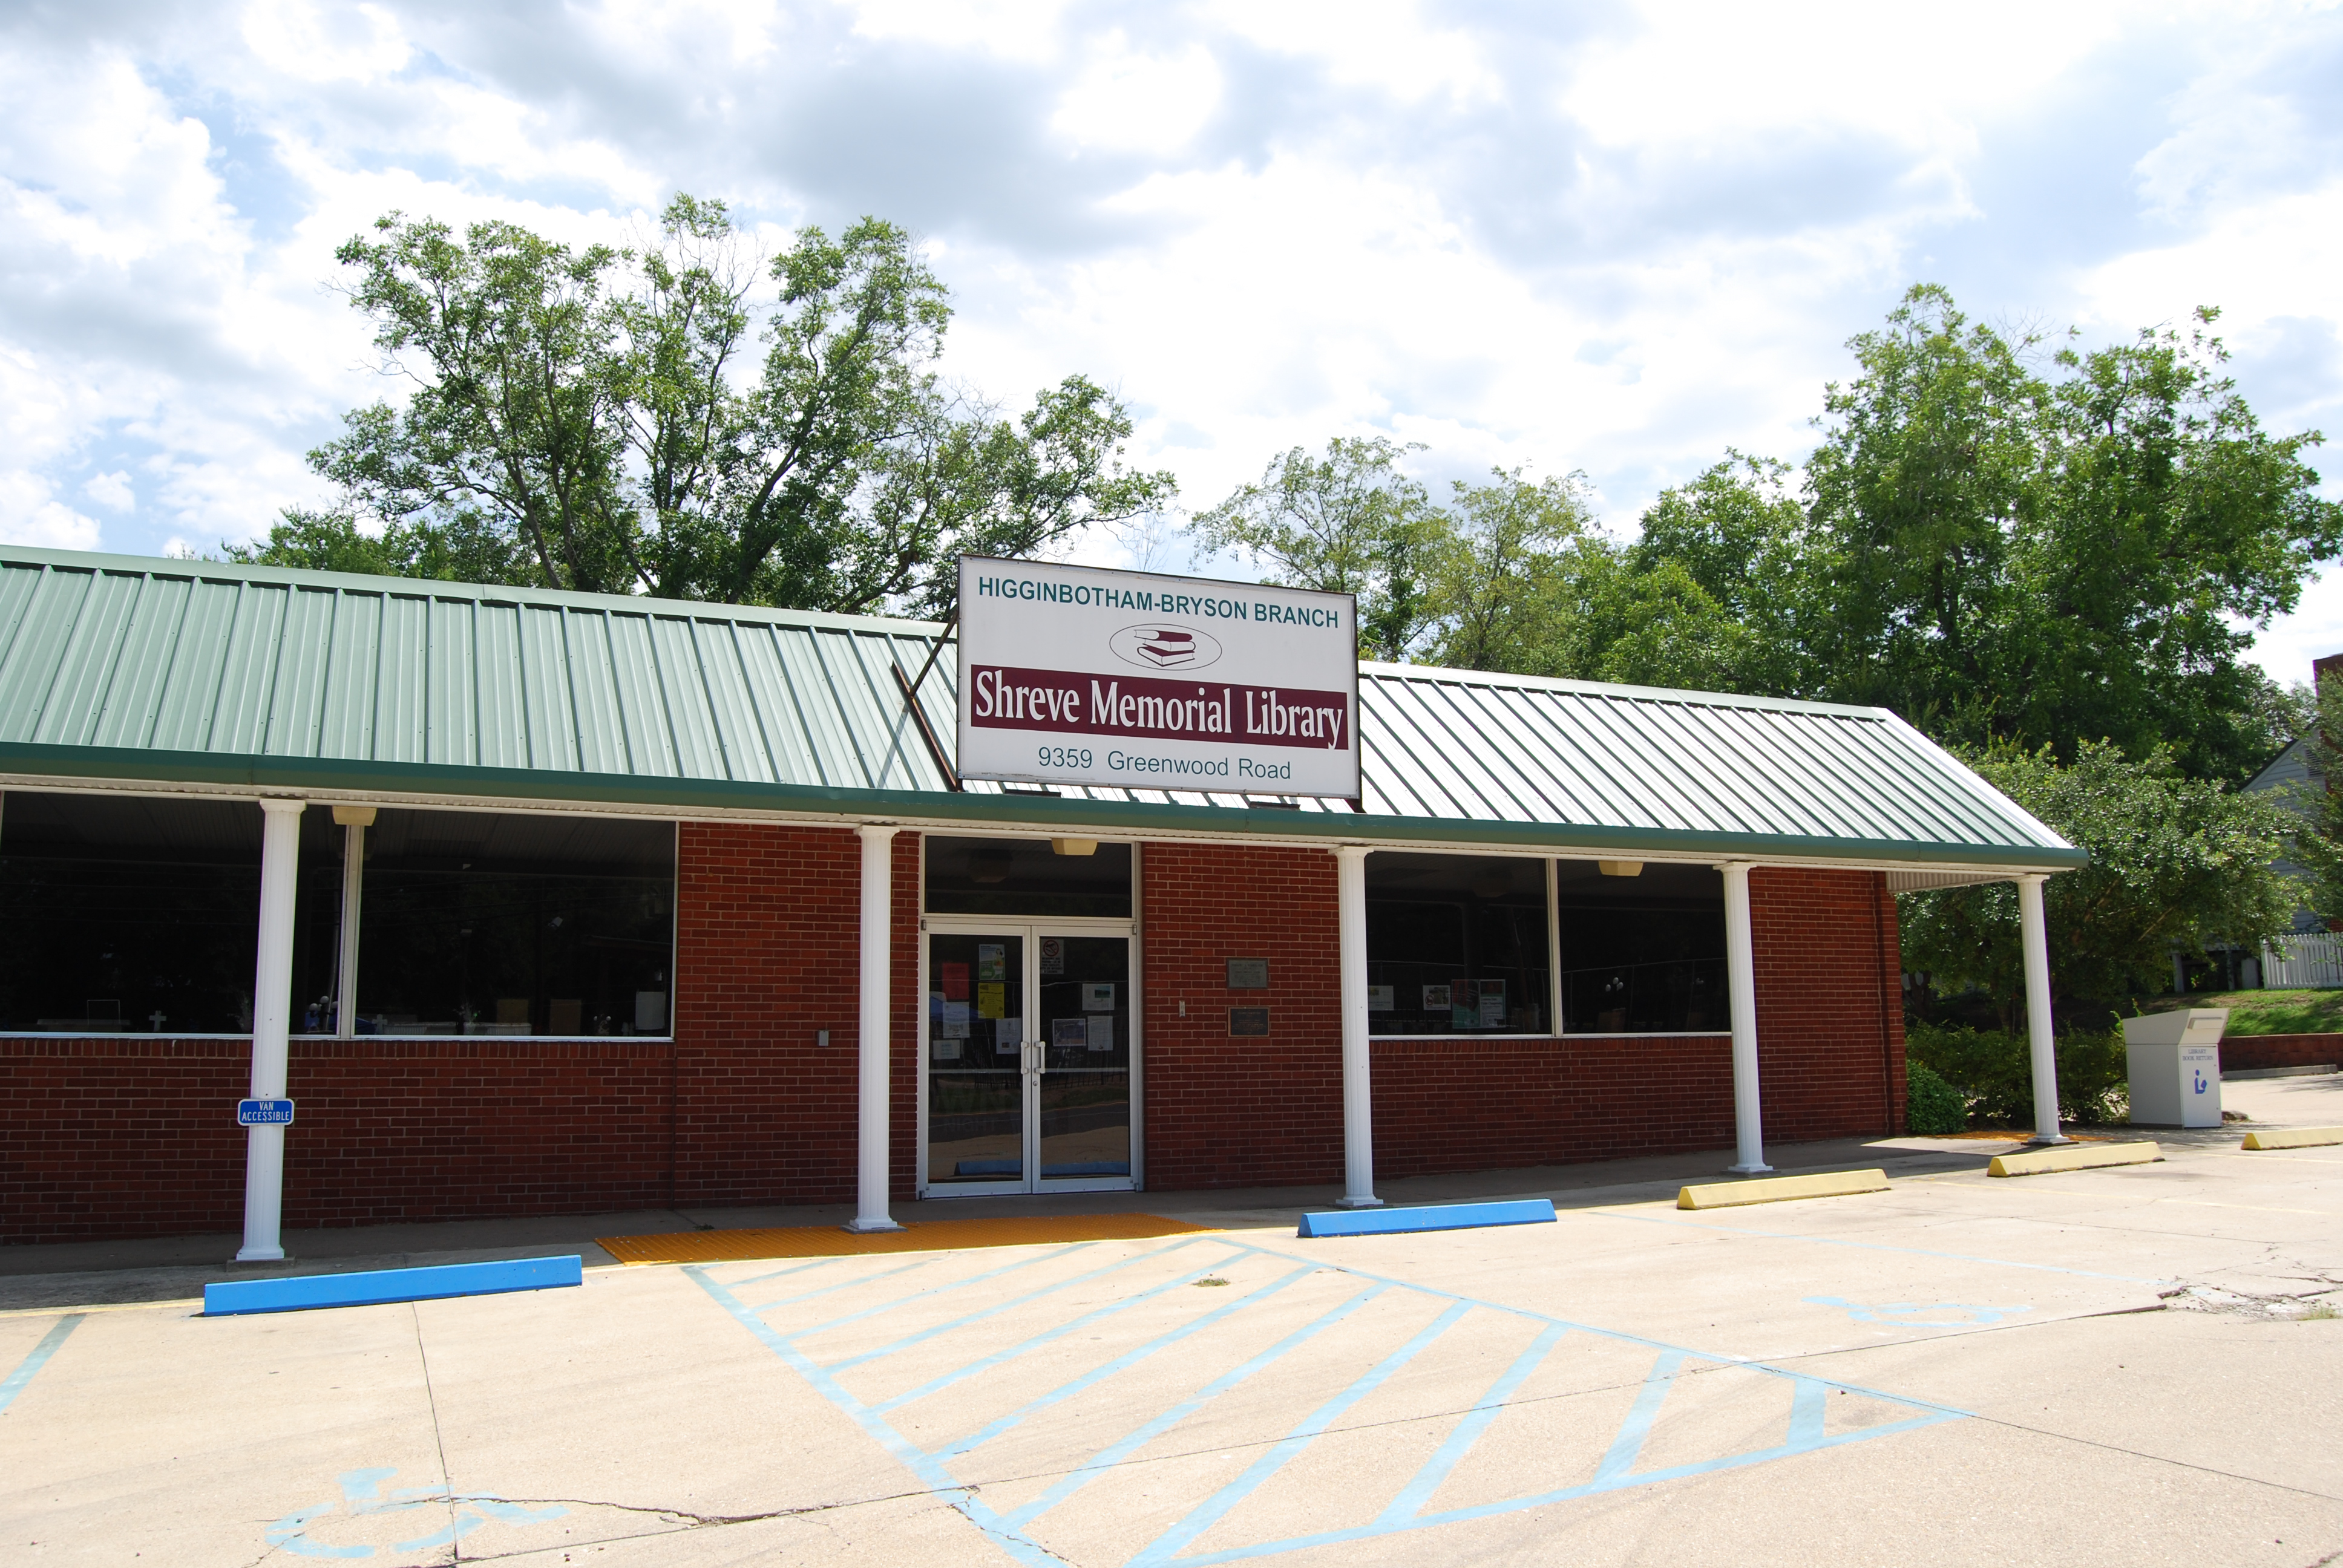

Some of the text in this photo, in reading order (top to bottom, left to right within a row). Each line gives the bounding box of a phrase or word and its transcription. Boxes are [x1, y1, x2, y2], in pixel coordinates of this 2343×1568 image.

[979, 576, 1339, 629] HIGGINBOTHAM-BRYSON BRANCH
[976, 669, 1343, 750] Shreve Memorial Library
[1038, 746, 1291, 780] 9359 Greenwood Road
[241, 1111, 290, 1121] ACCESSIBLE
[259, 1102, 274, 1111] VAN
